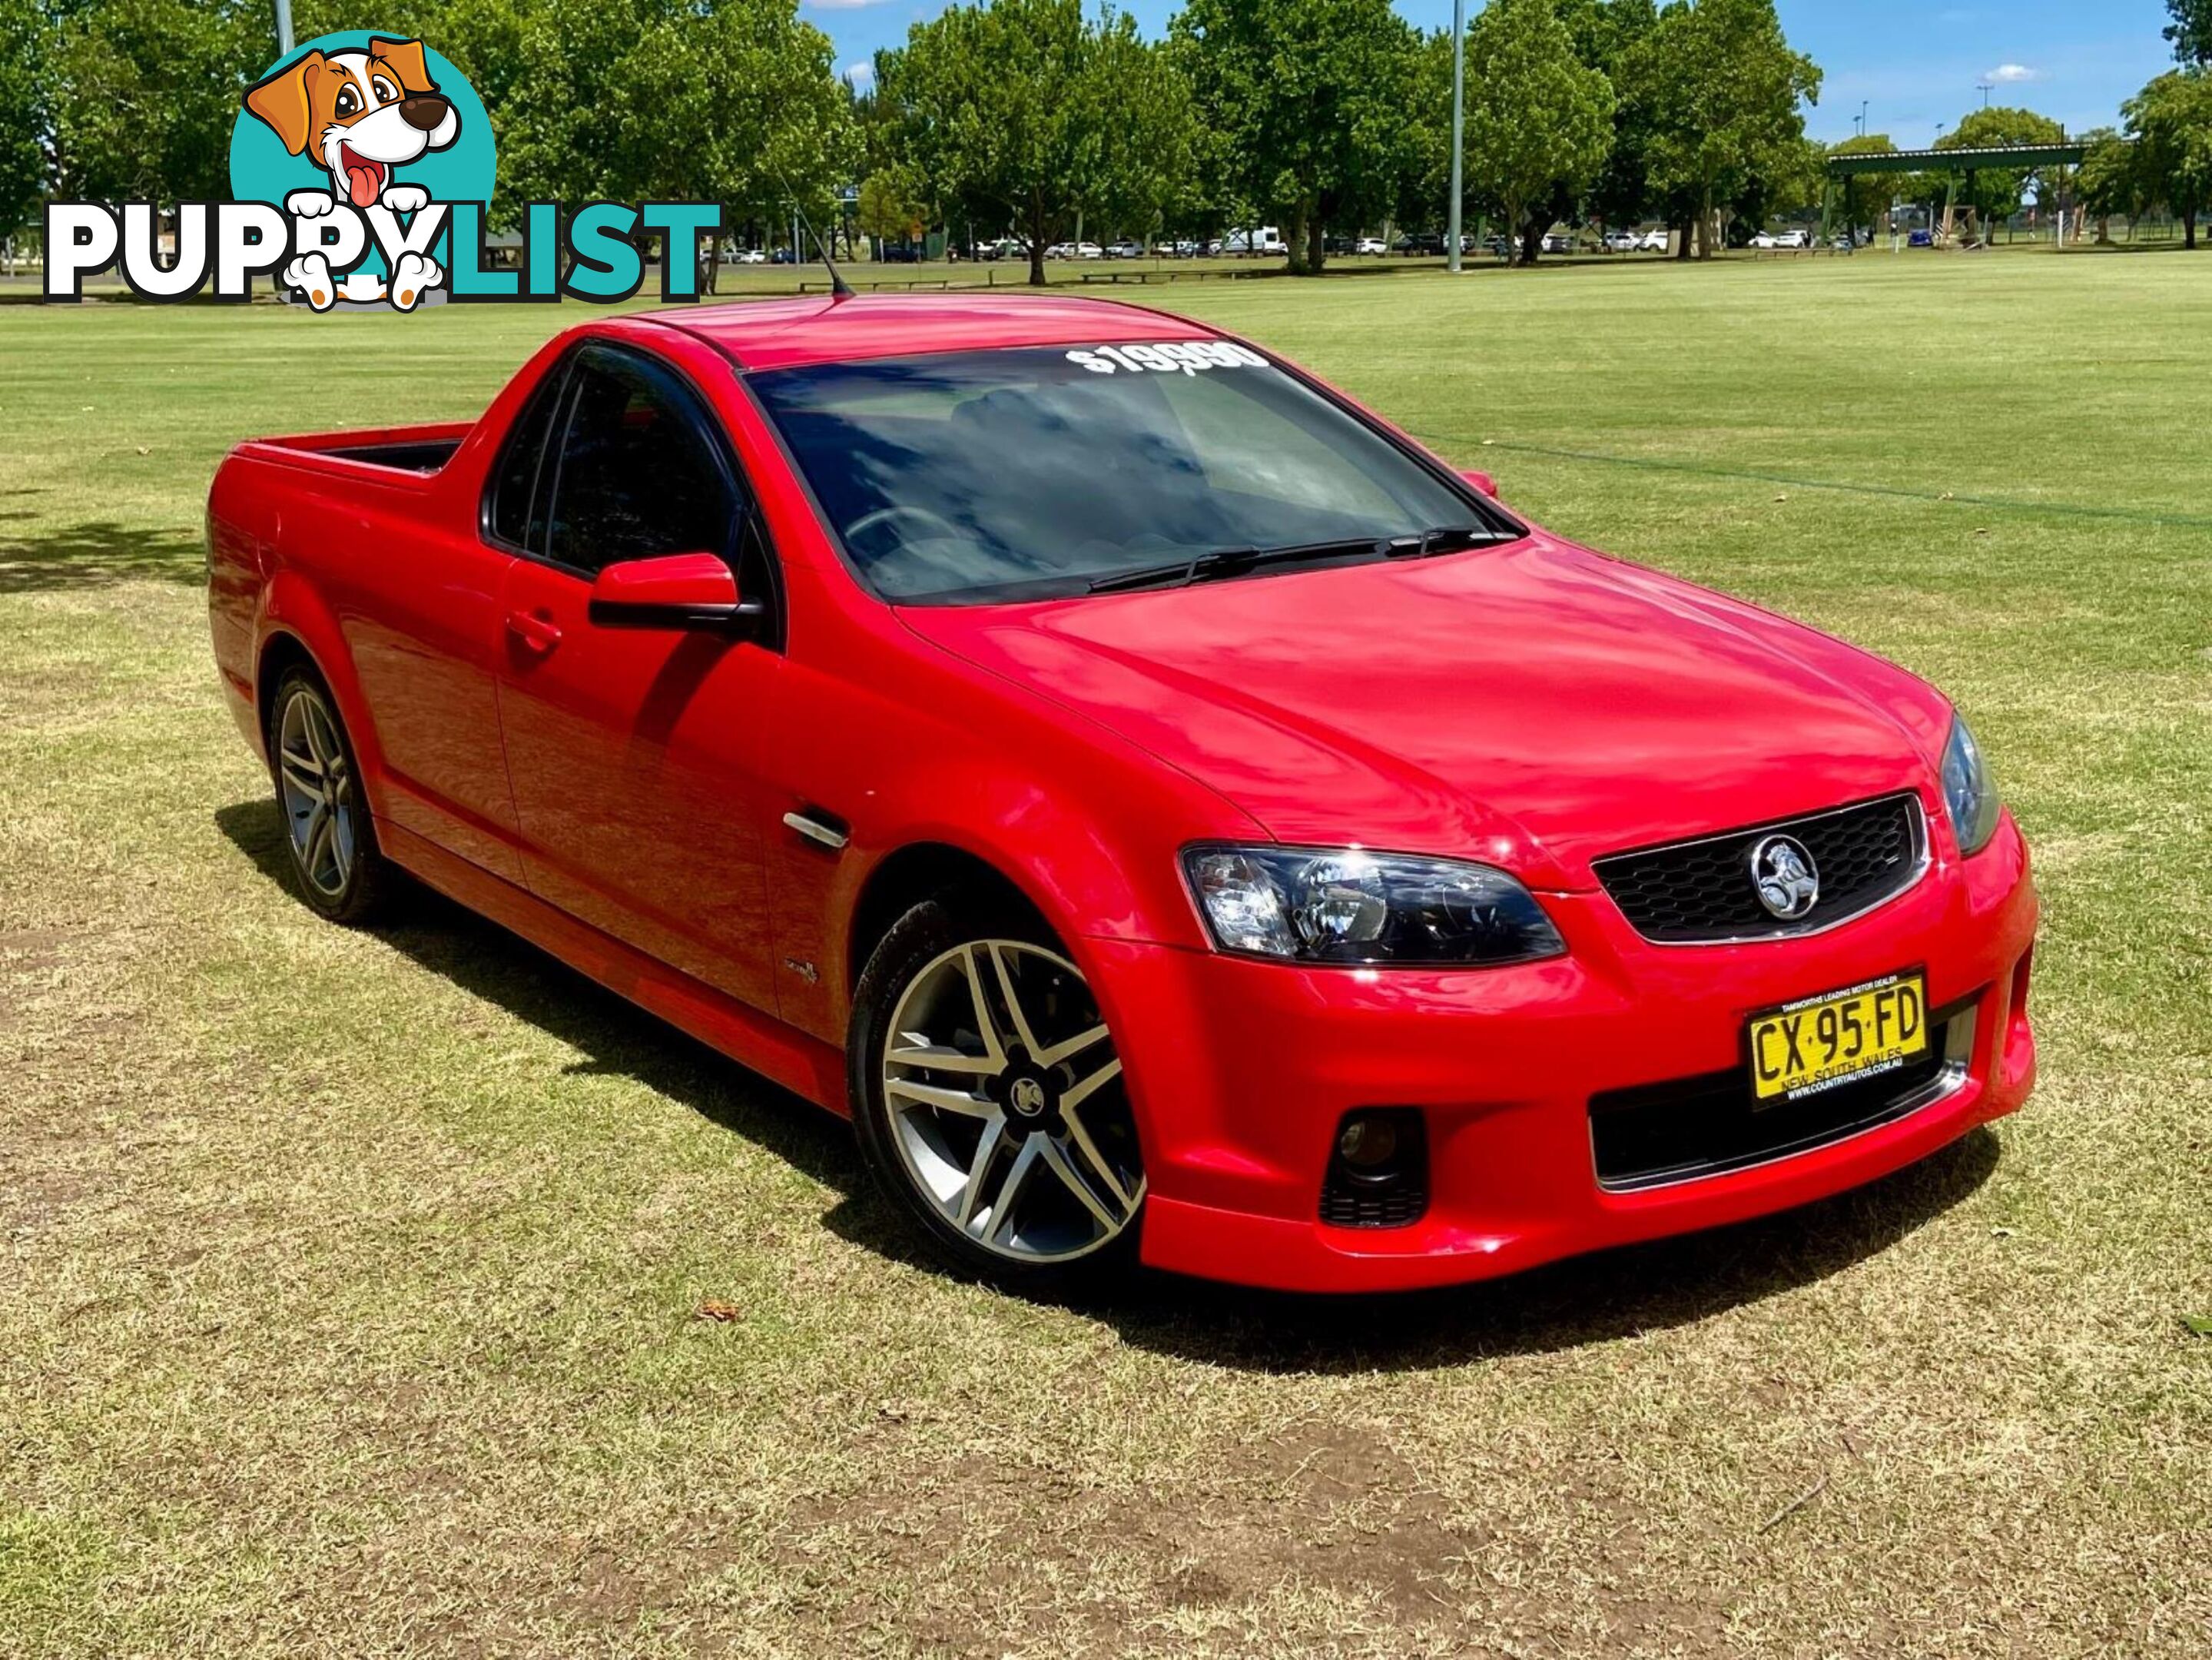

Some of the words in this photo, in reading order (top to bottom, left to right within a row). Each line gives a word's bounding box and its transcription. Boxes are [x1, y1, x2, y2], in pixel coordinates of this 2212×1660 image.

[1066, 342, 1269, 376] $19,990
[1824, 989, 1850, 1001] LEADING
[1851, 982, 1873, 994] MOTOR
[1874, 975, 1897, 988] DEALER
[1781, 1074, 1809, 1091] NEW
[1815, 1060, 1855, 1079] SOUTH
[1862, 1046, 1902, 1067] WALES
[1787, 1057, 1902, 1100] WWW.COUNTRYAUTOS.COM.AU
